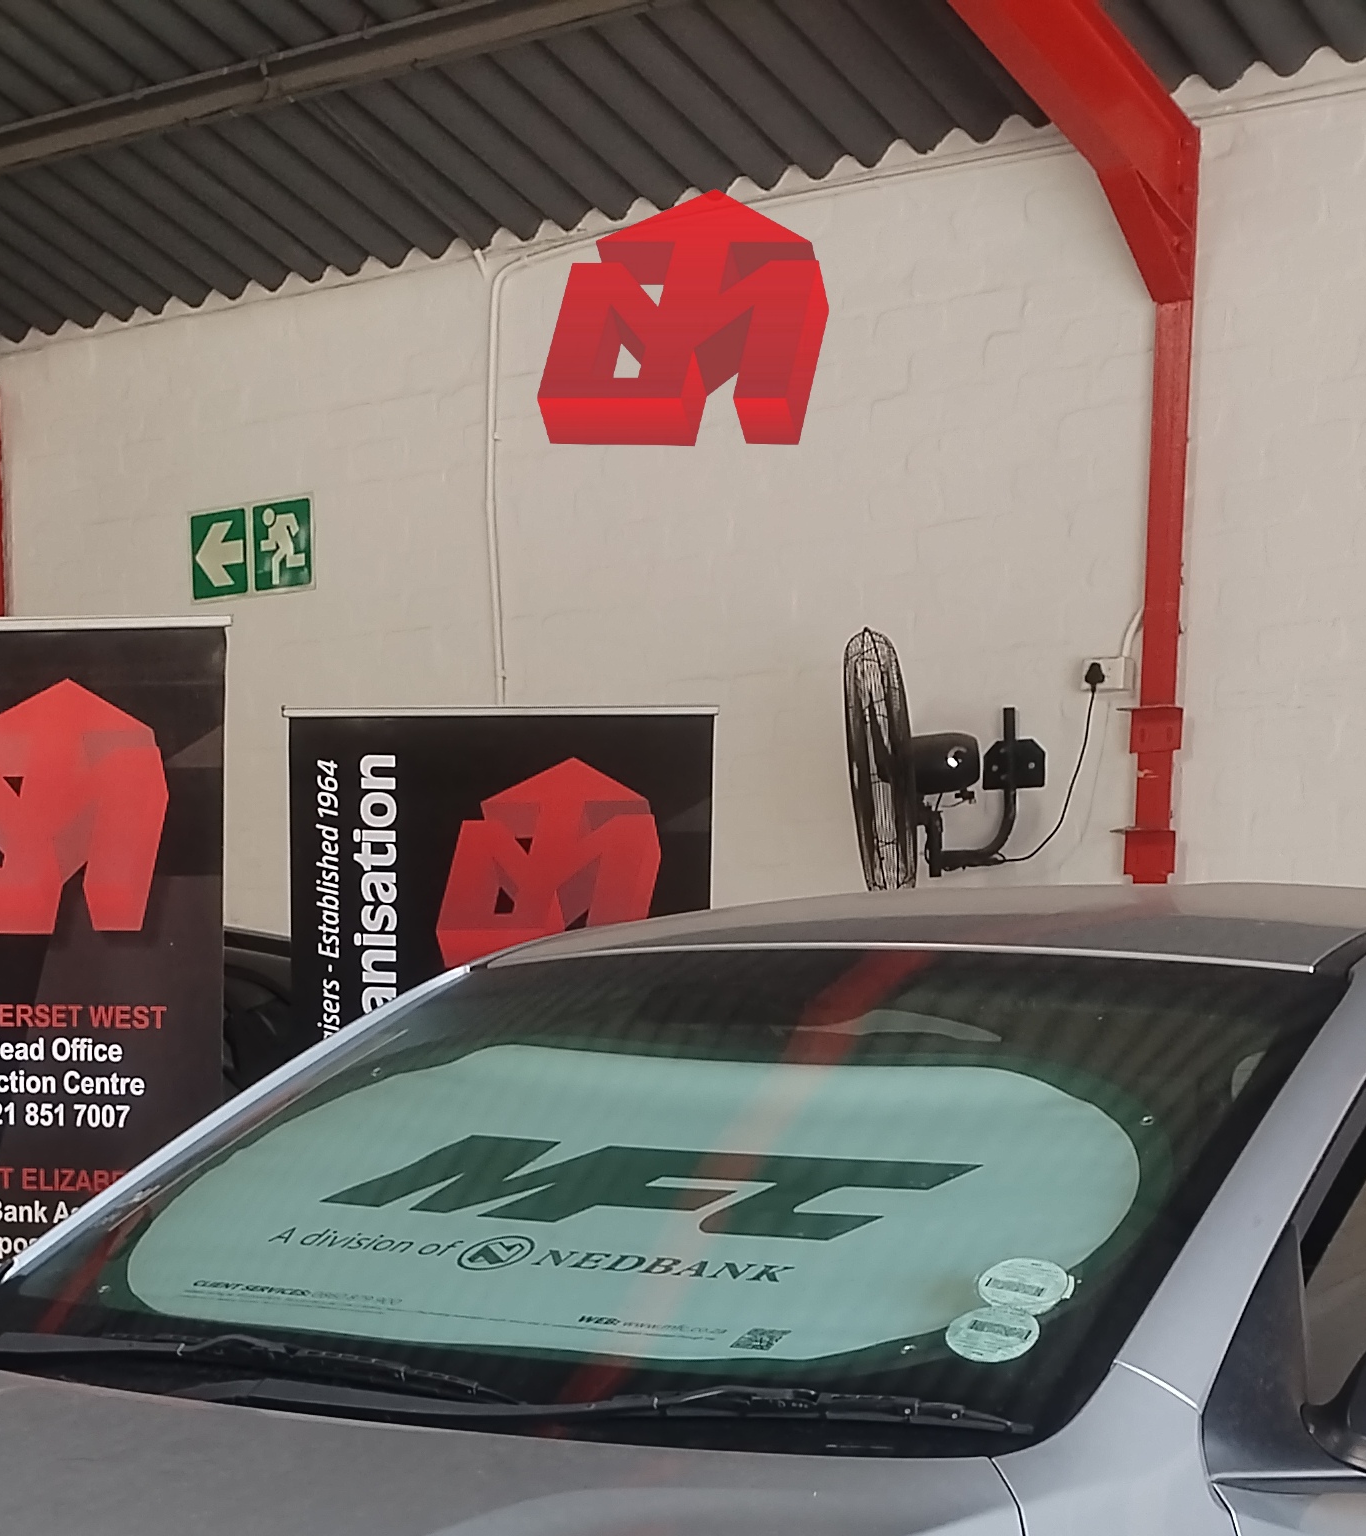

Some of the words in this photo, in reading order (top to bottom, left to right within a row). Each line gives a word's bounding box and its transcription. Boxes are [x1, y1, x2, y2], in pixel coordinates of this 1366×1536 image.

[316, 759, 339, 818] 1964
[315, 823, 340, 959] Established
[89, 1005, 168, 1030] WEST
[52, 1037, 123, 1062] Office
[63, 1070, 145, 1096] Centre
[25, 1102, 65, 1127] 851
[73, 1104, 131, 1128] 7007
[268, 1227, 297, 1243] A
[300, 1228, 414, 1254] division
[417, 1240, 464, 1256] of
[531, 1248, 795, 1283] NEDBANK
